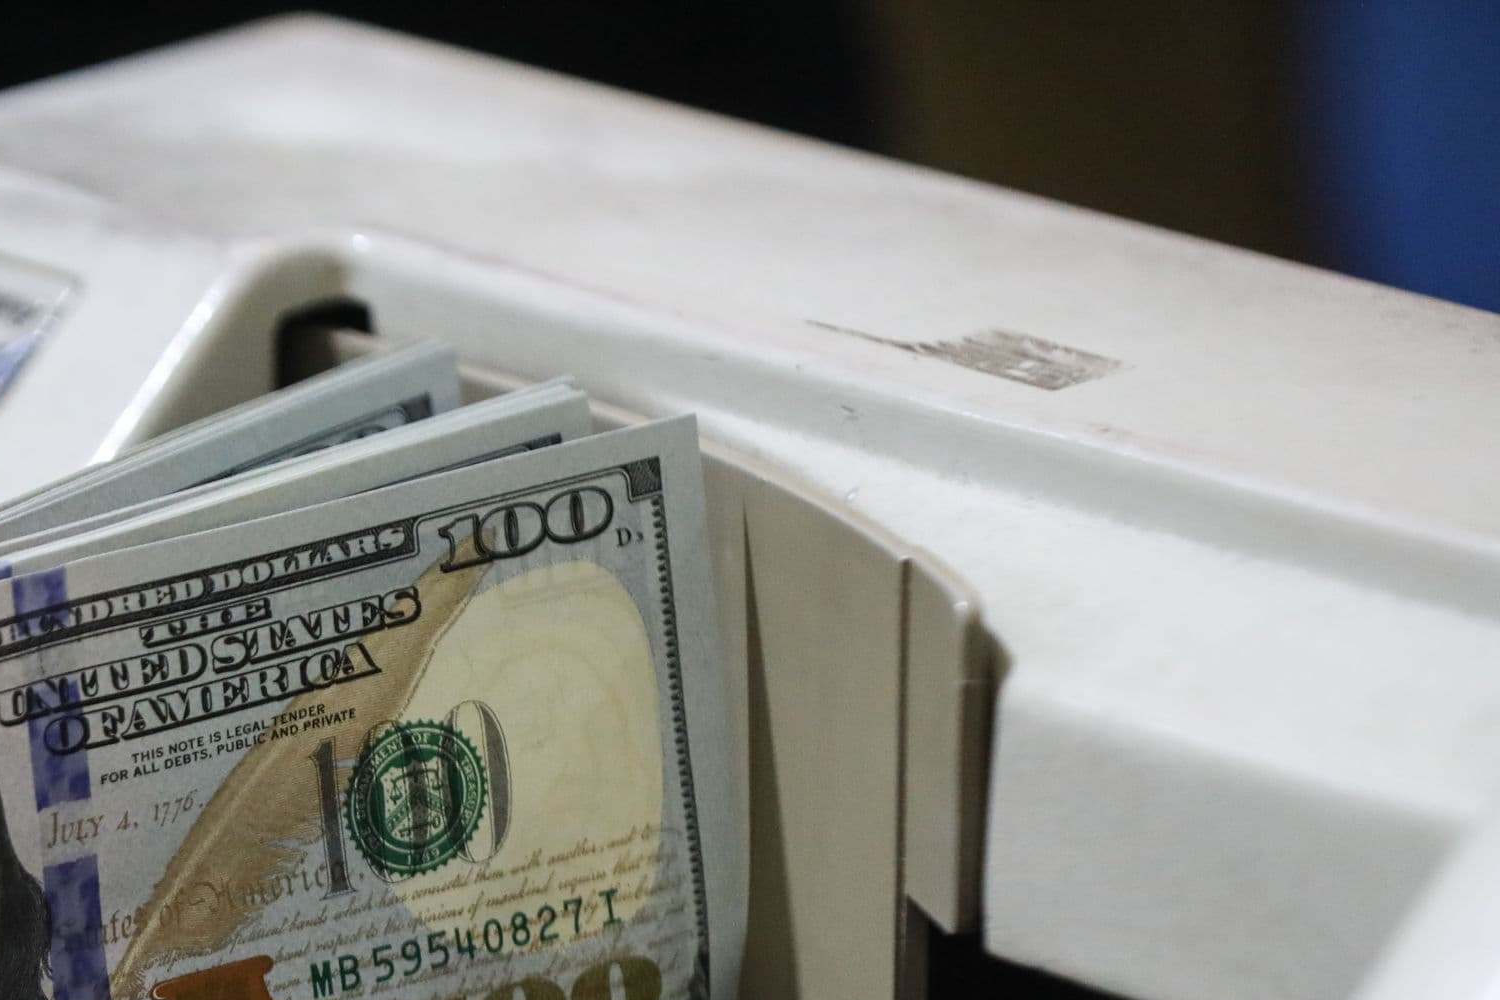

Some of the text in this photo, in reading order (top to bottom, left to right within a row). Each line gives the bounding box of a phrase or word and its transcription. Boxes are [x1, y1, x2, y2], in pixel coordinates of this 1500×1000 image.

[208, 524, 409, 593] DOLLARS
[439, 484, 615, 574] 100
[139, 597, 272, 649] THE
[211, 584, 422, 674] STATES
[43, 640, 383, 756] OF AMERICA
[131, 703, 327, 765] THIS NOTE IS LEGAL TENDER
[100, 707, 357, 786] FOR ALL DEBTS, PUBLIC AND PRIVATE
